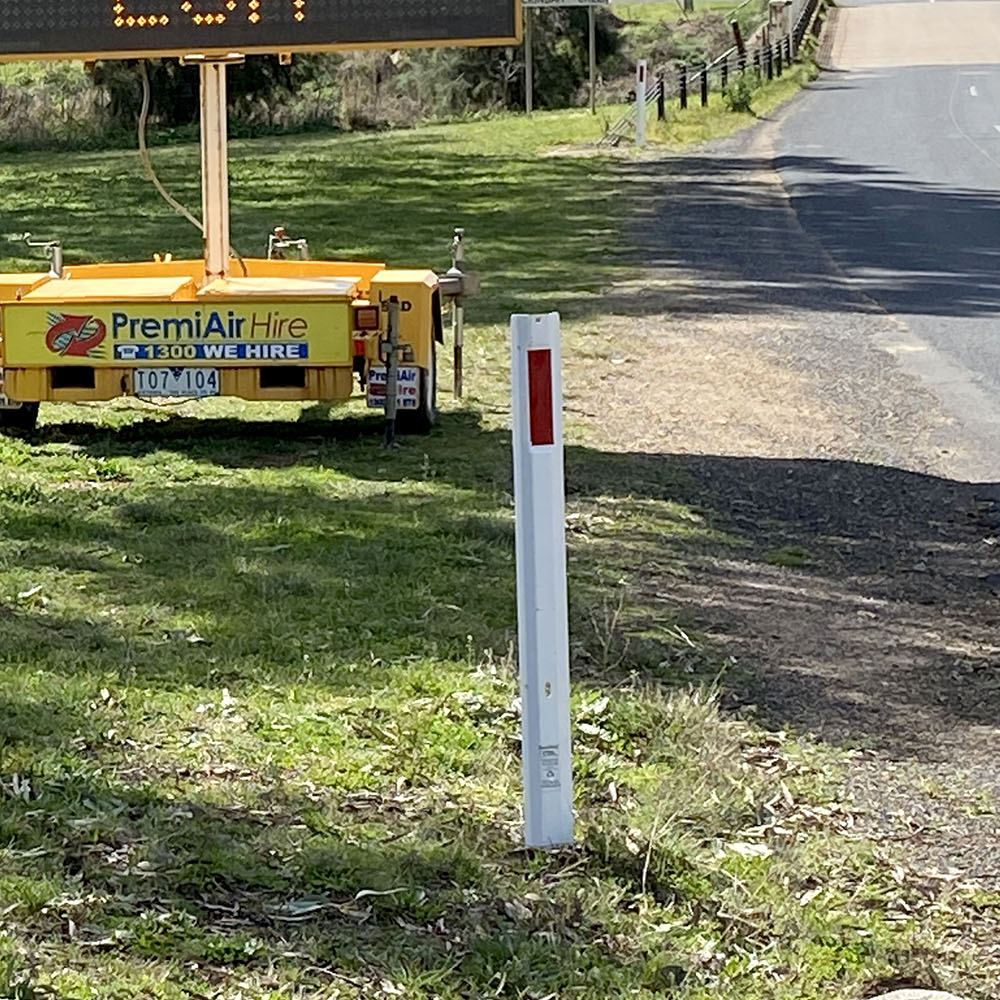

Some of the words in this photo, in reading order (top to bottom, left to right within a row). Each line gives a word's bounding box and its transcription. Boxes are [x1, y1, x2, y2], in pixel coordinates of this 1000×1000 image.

[112, 311, 246, 340] PremiAir
[250, 311, 308, 338] Hire
[144, 345, 197, 359] 1300
[203, 344, 239, 359] WE
[245, 344, 301, 358] HIRE
[137, 370, 169, 390] T07
[186, 370, 217, 390] 104
